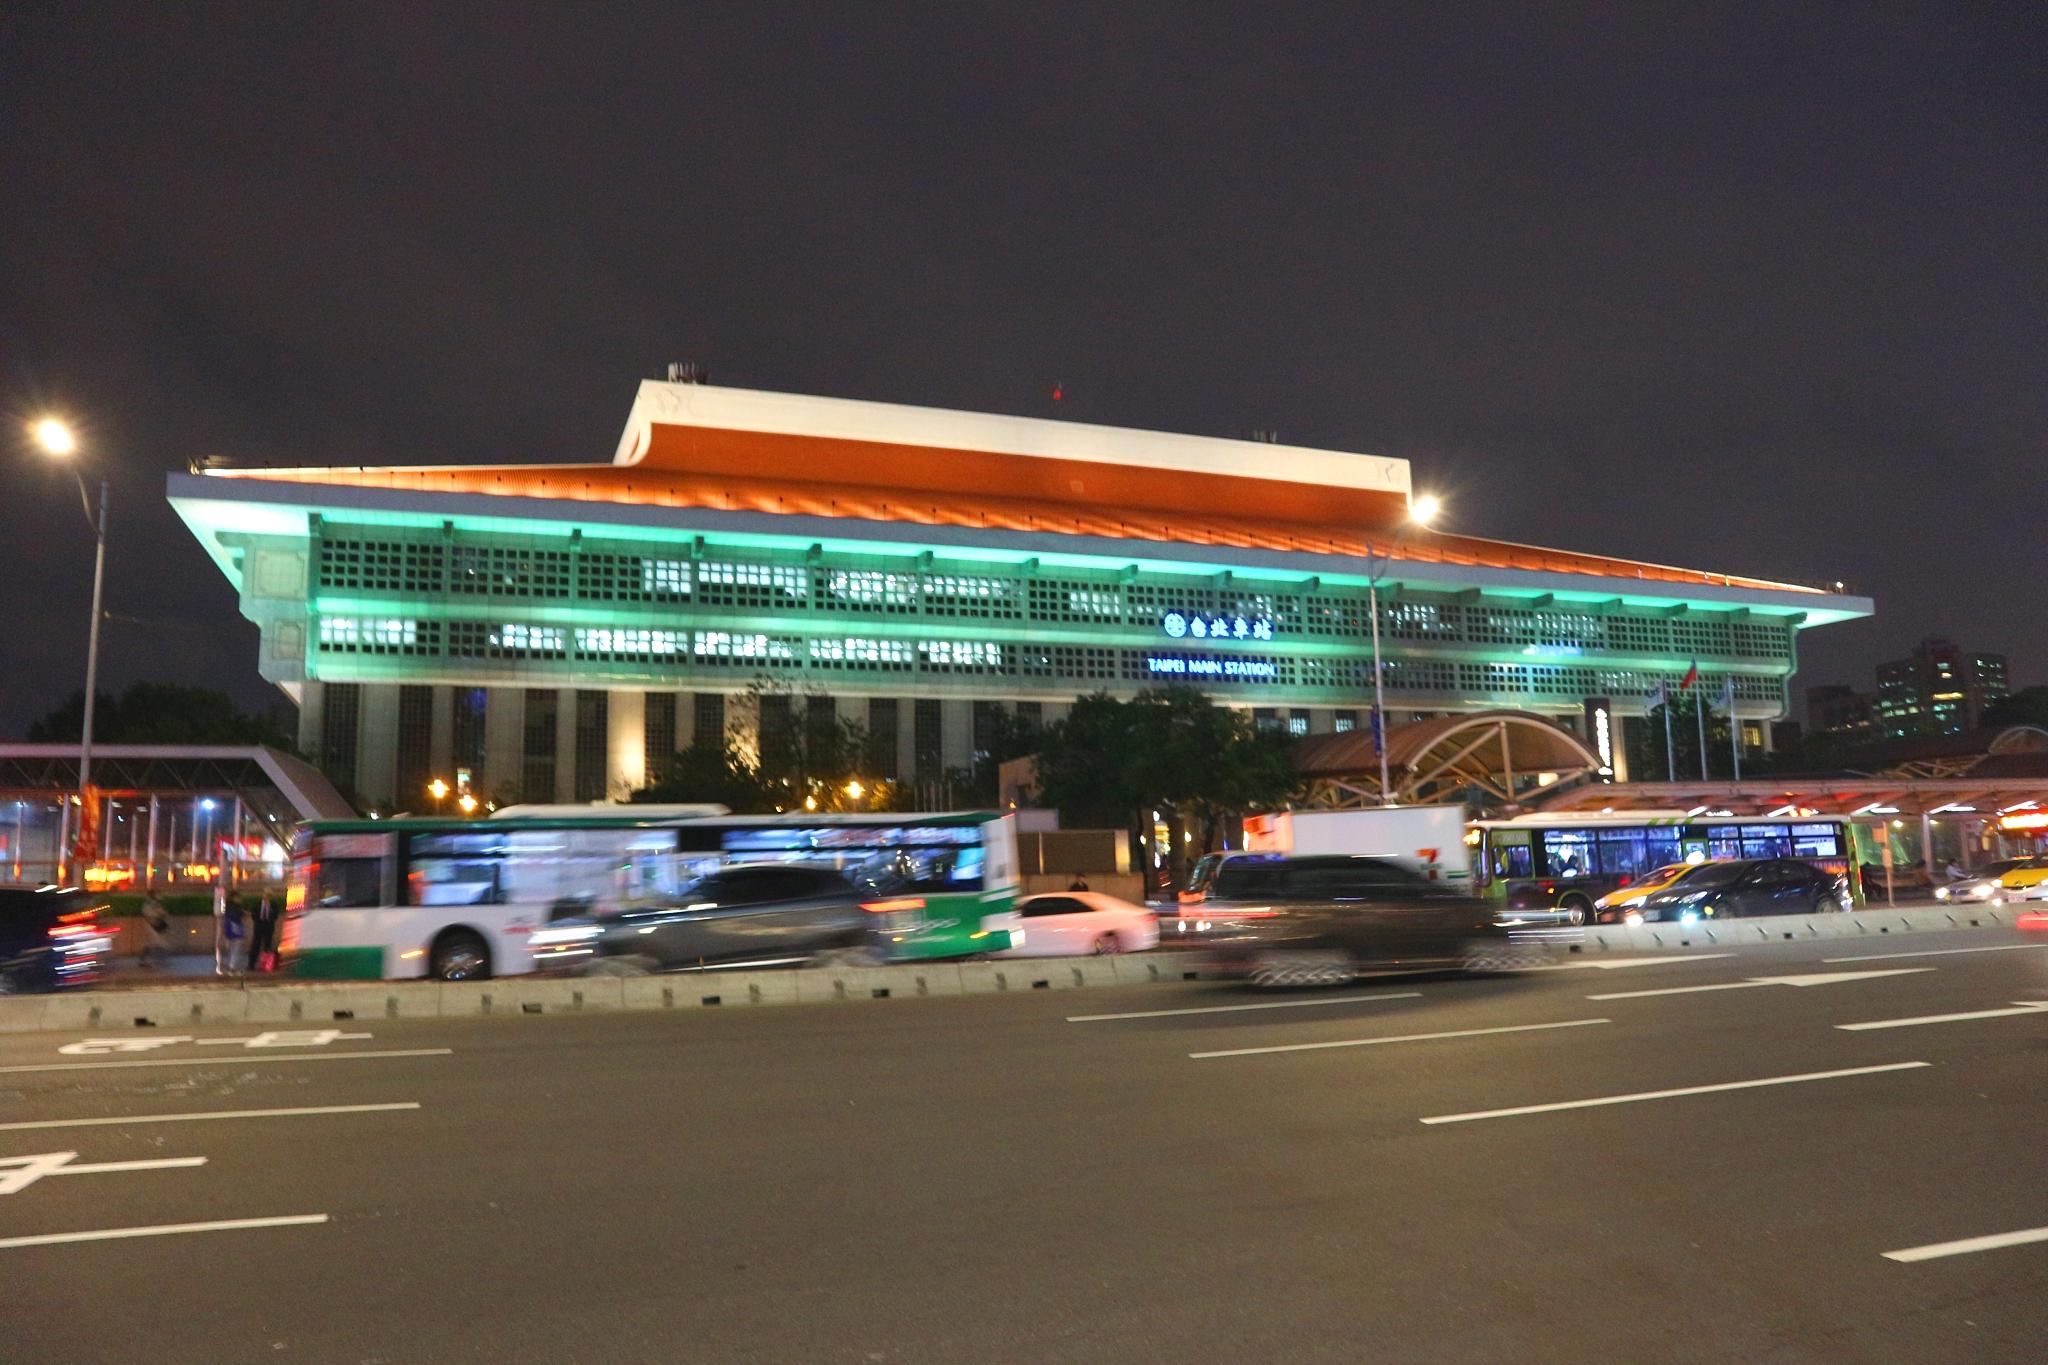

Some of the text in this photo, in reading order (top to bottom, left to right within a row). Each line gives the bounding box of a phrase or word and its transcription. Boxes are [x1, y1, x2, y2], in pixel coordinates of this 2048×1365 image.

[1148, 658, 1275, 676] TAIPEI MAIN STATION
